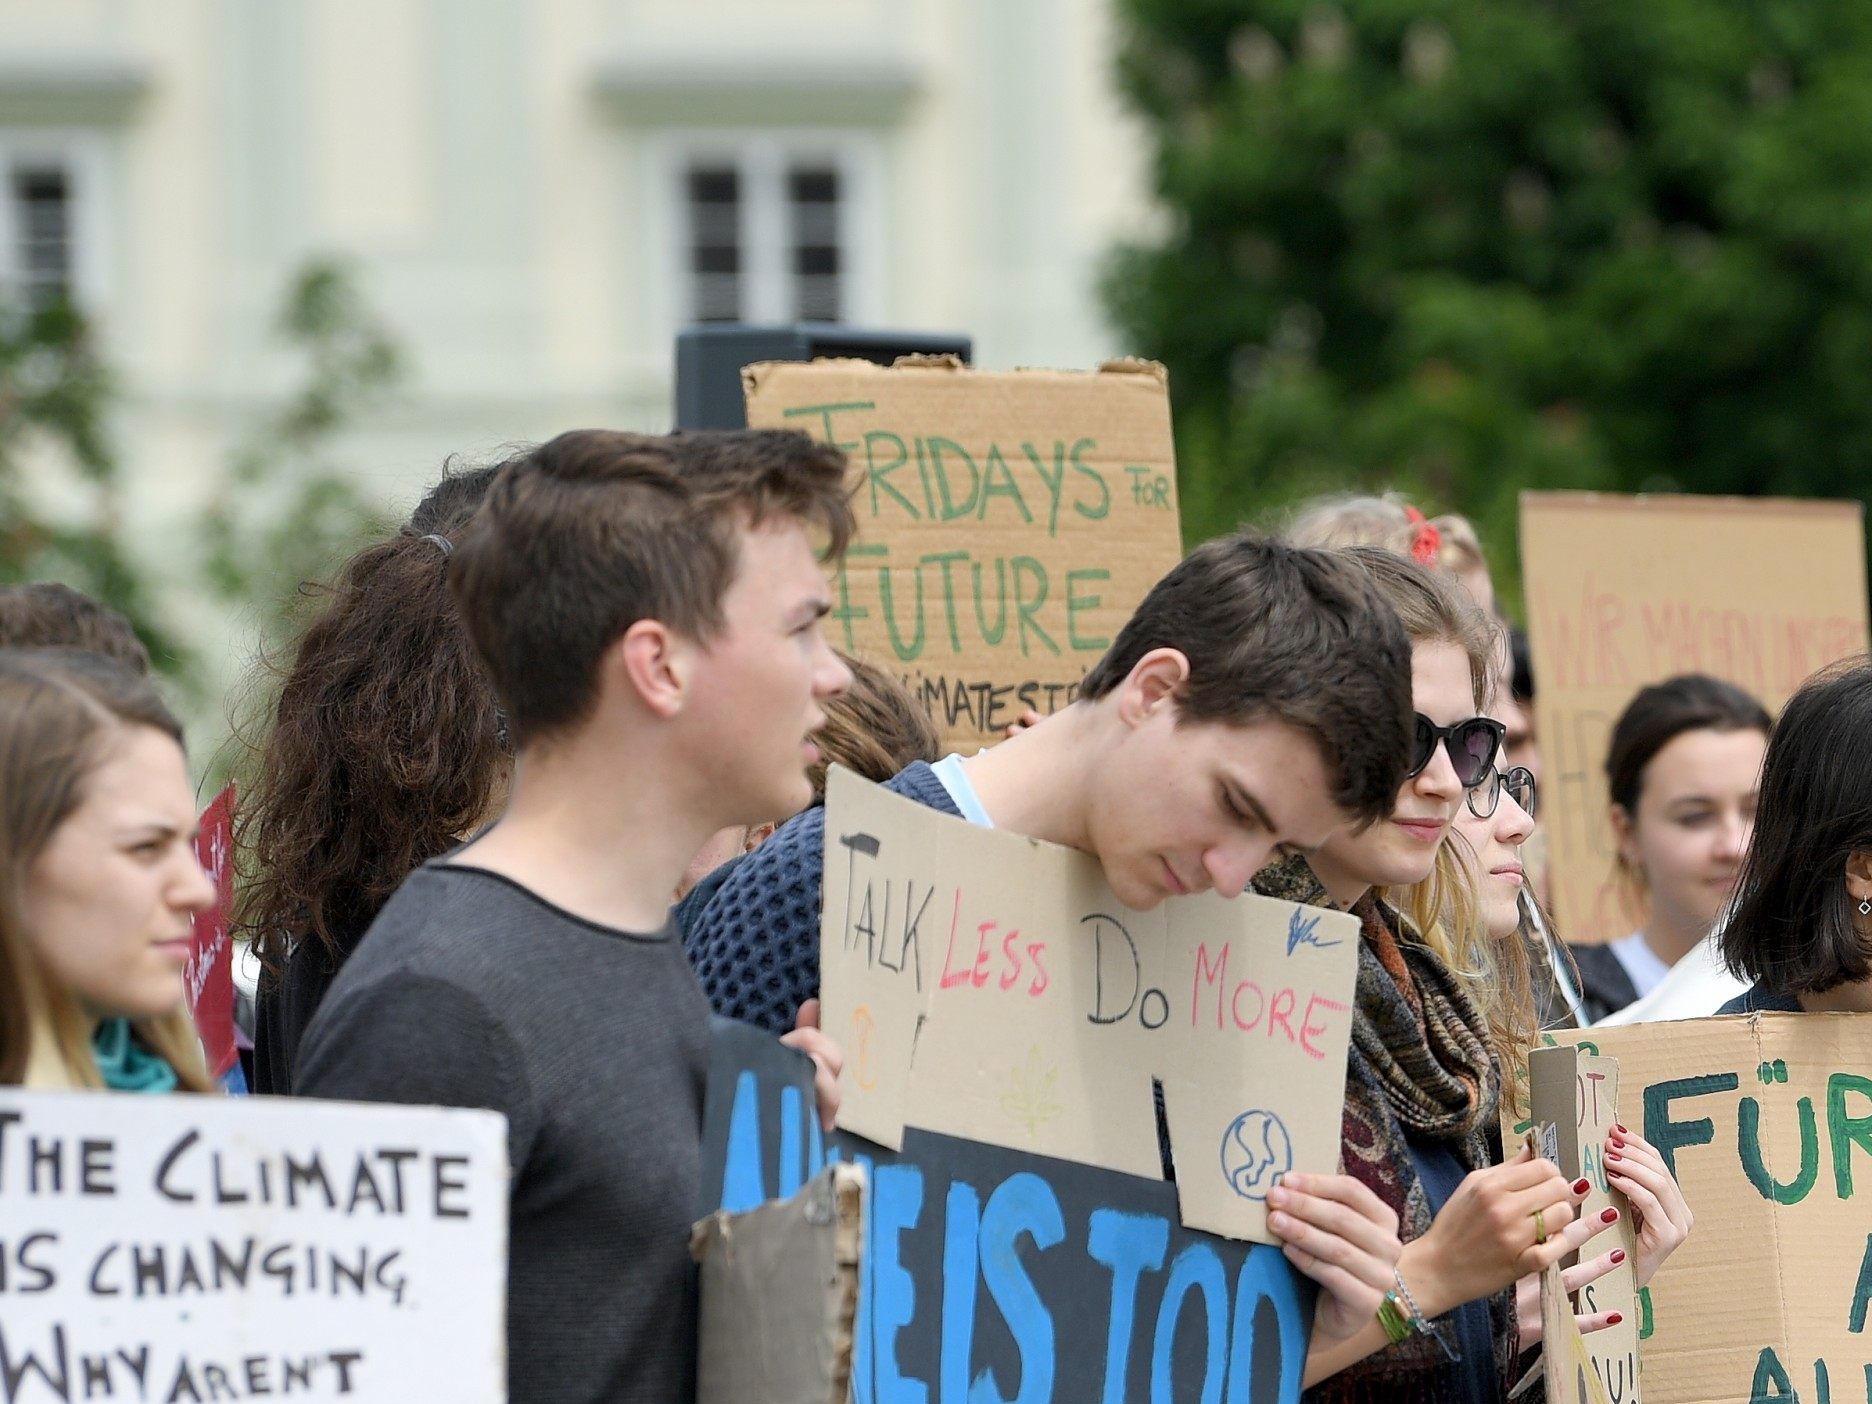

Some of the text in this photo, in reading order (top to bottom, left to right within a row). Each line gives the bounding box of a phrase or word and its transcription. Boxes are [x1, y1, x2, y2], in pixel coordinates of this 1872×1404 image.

[783, 400, 1110, 538] FRIDAYS
[811, 543, 1111, 662] FUTURE
[940, 886, 1049, 997] LESS
[1191, 940, 1350, 1061] MORE
[154, 1128, 472, 1220] CLIMATE
